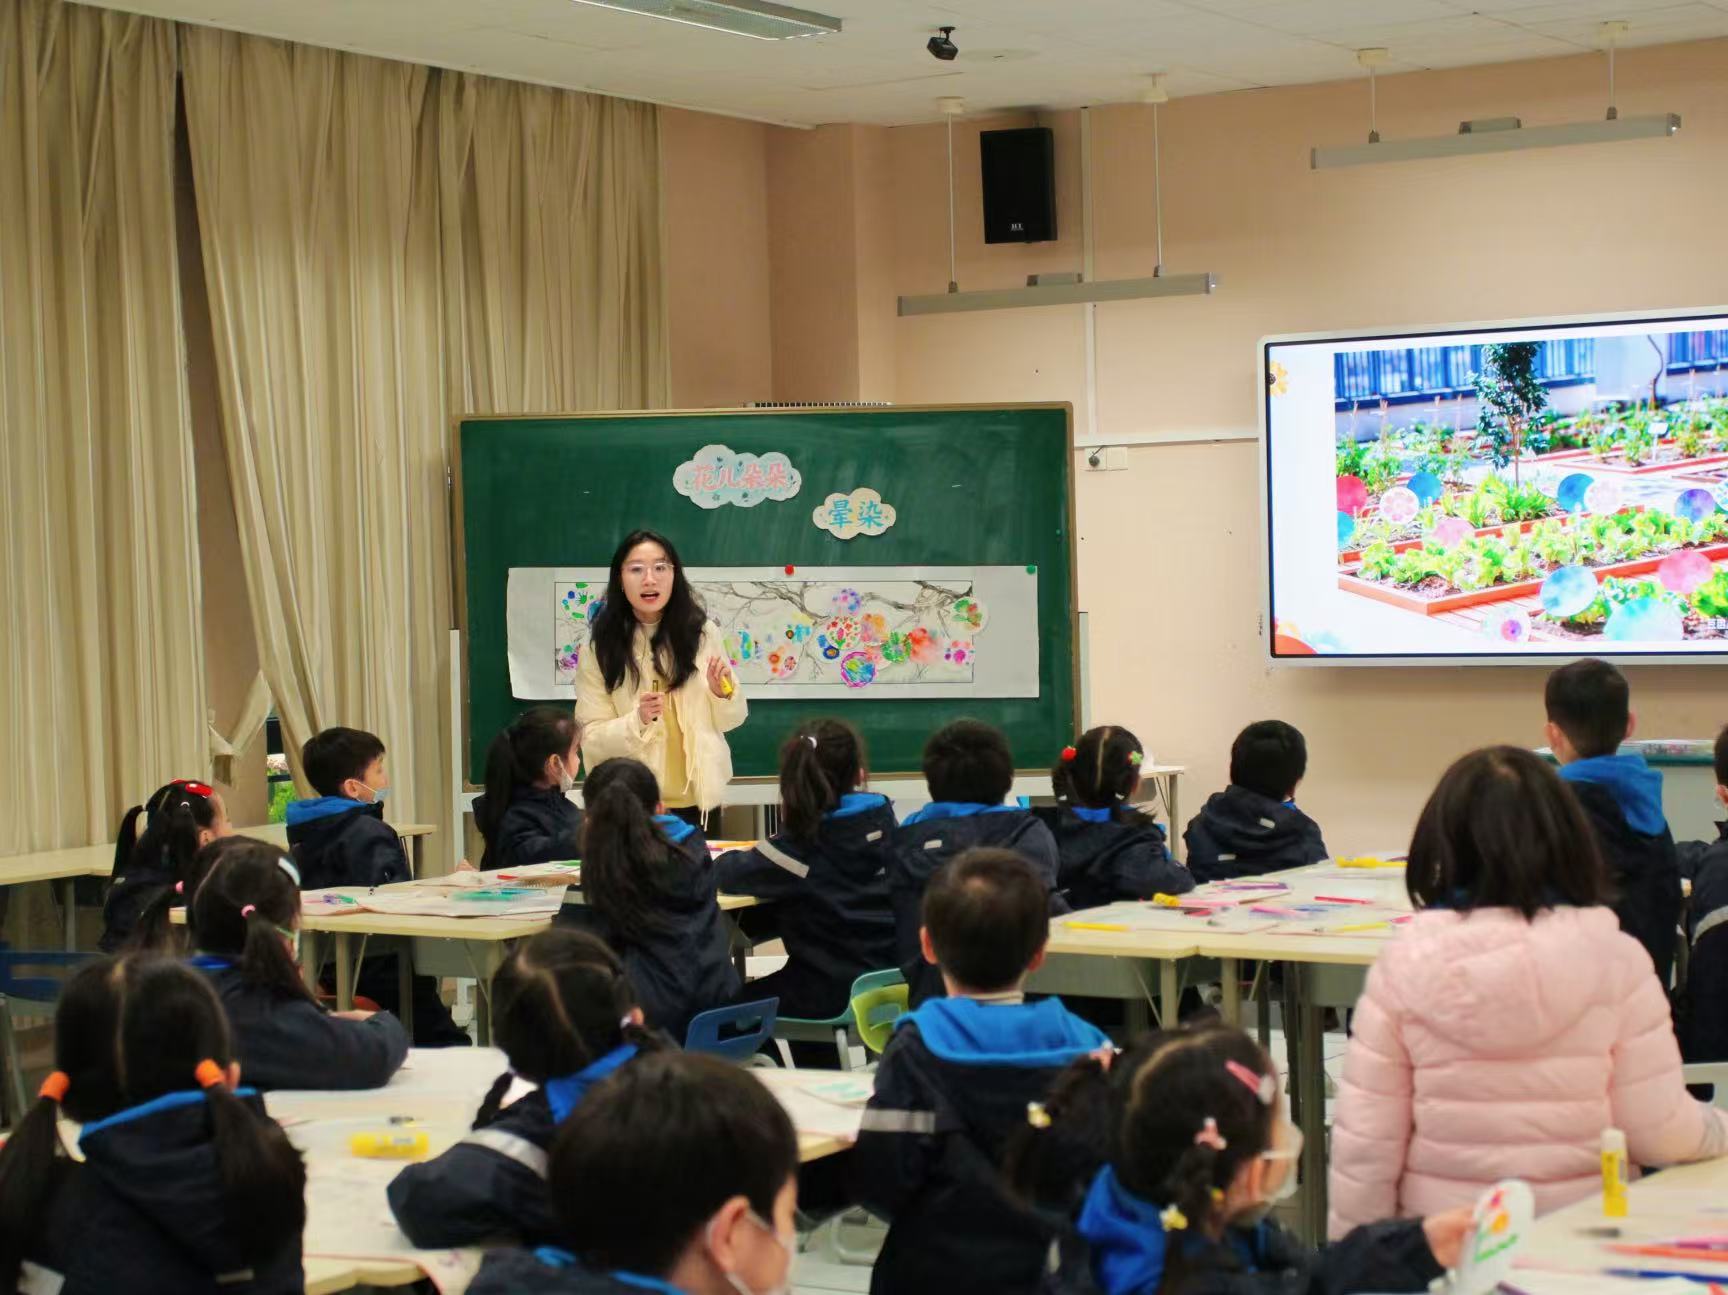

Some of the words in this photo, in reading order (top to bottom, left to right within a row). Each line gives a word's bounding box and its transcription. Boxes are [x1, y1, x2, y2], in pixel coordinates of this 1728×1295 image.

[693, 463, 788, 492] 花儿朵朵
[828, 499, 885, 529] 晕染
